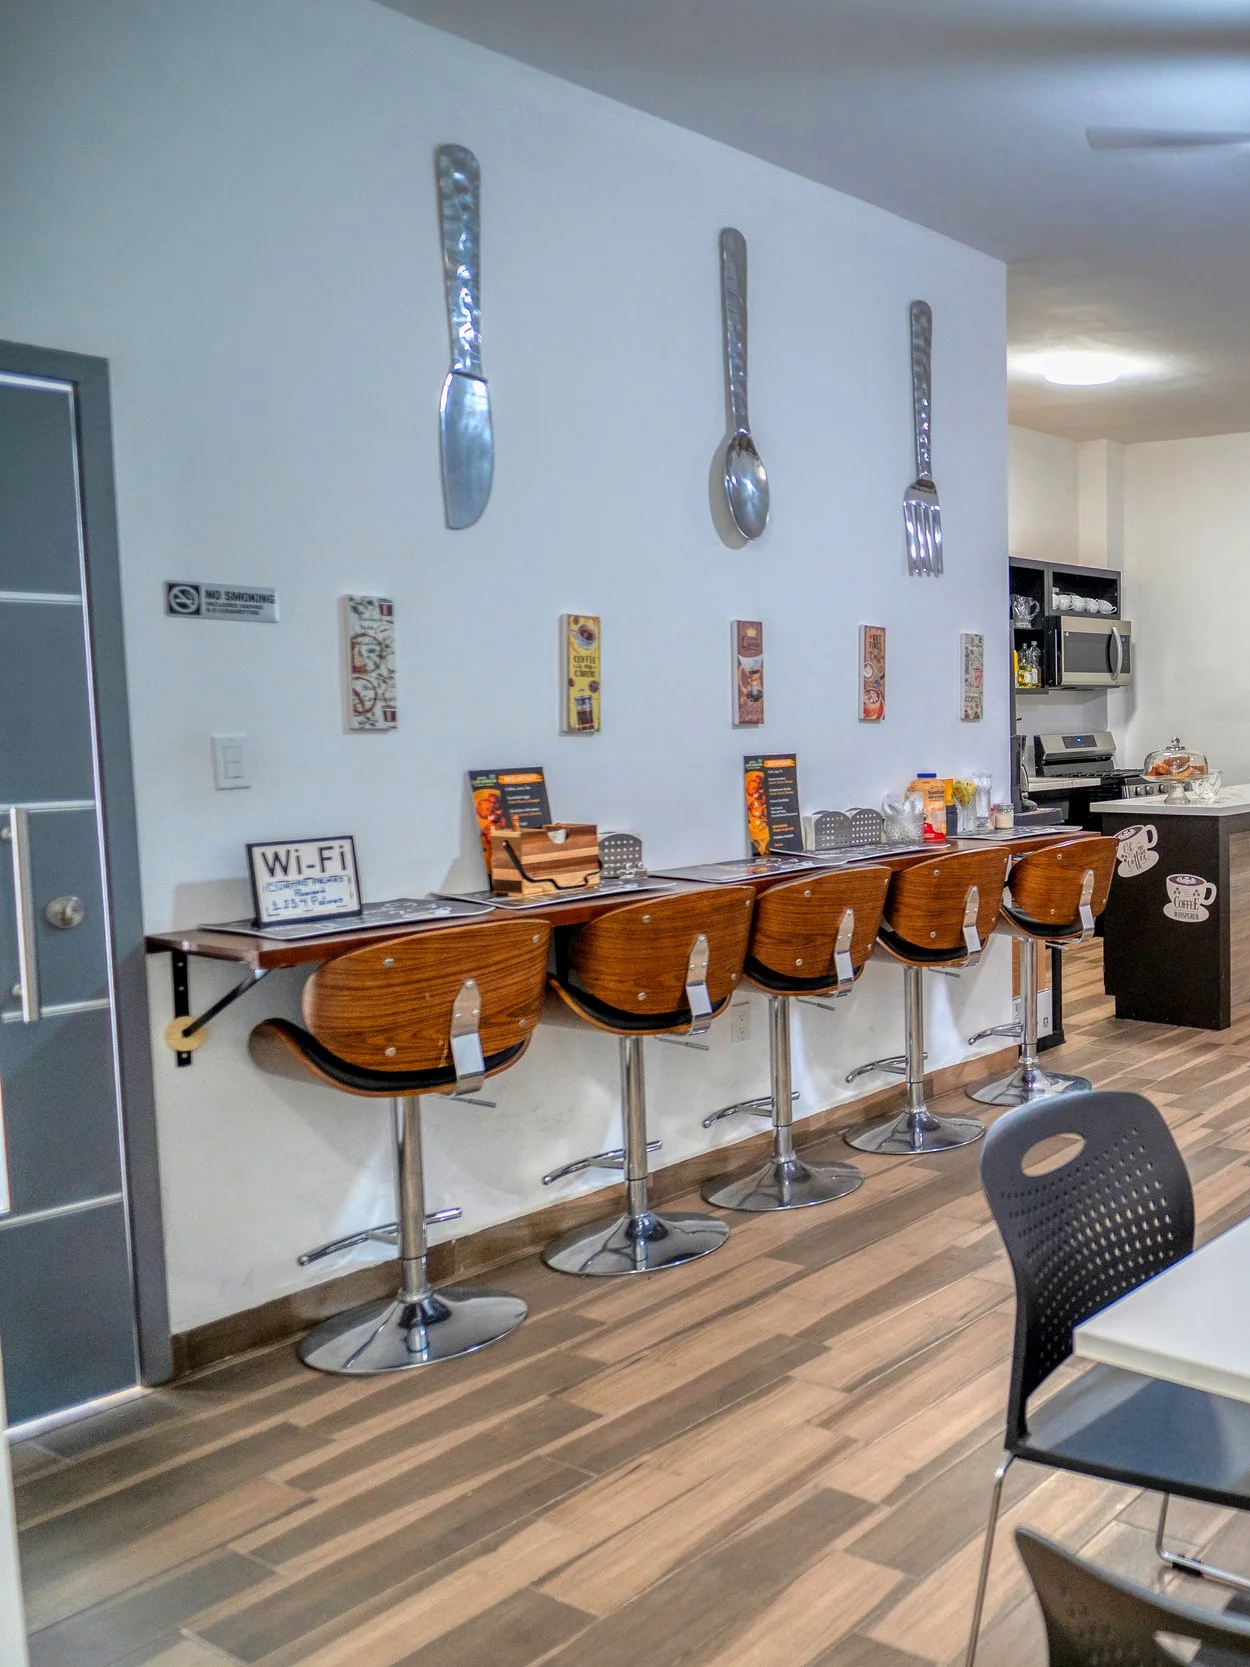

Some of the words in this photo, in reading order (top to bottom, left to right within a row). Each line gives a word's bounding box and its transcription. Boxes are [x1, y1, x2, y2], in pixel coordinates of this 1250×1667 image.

[204, 590, 222, 600] NO
[224, 590, 276, 604] SMOKING
[261, 845, 347, 877] Wi-Fi
[1174, 896, 1200, 910] COFFEE
[1174, 912, 1200, 920] WHISPERER
